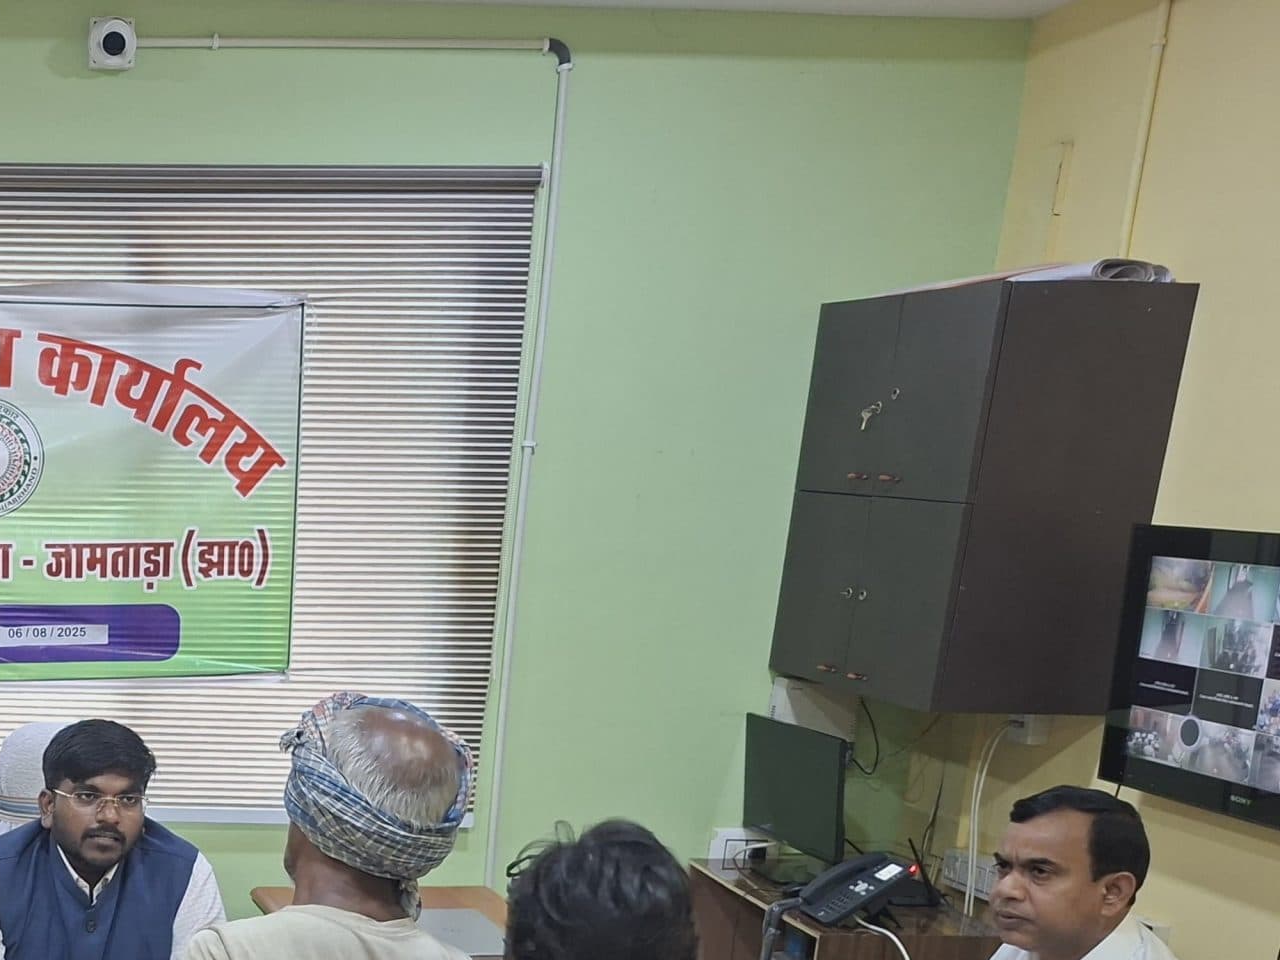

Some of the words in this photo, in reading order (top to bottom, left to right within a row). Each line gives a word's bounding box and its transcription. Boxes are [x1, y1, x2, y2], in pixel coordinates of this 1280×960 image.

[37, 331, 287, 498] कार्यालय
[45, 541, 175, 590] जामताड़ा
[57, 627, 86, 638] 2025
